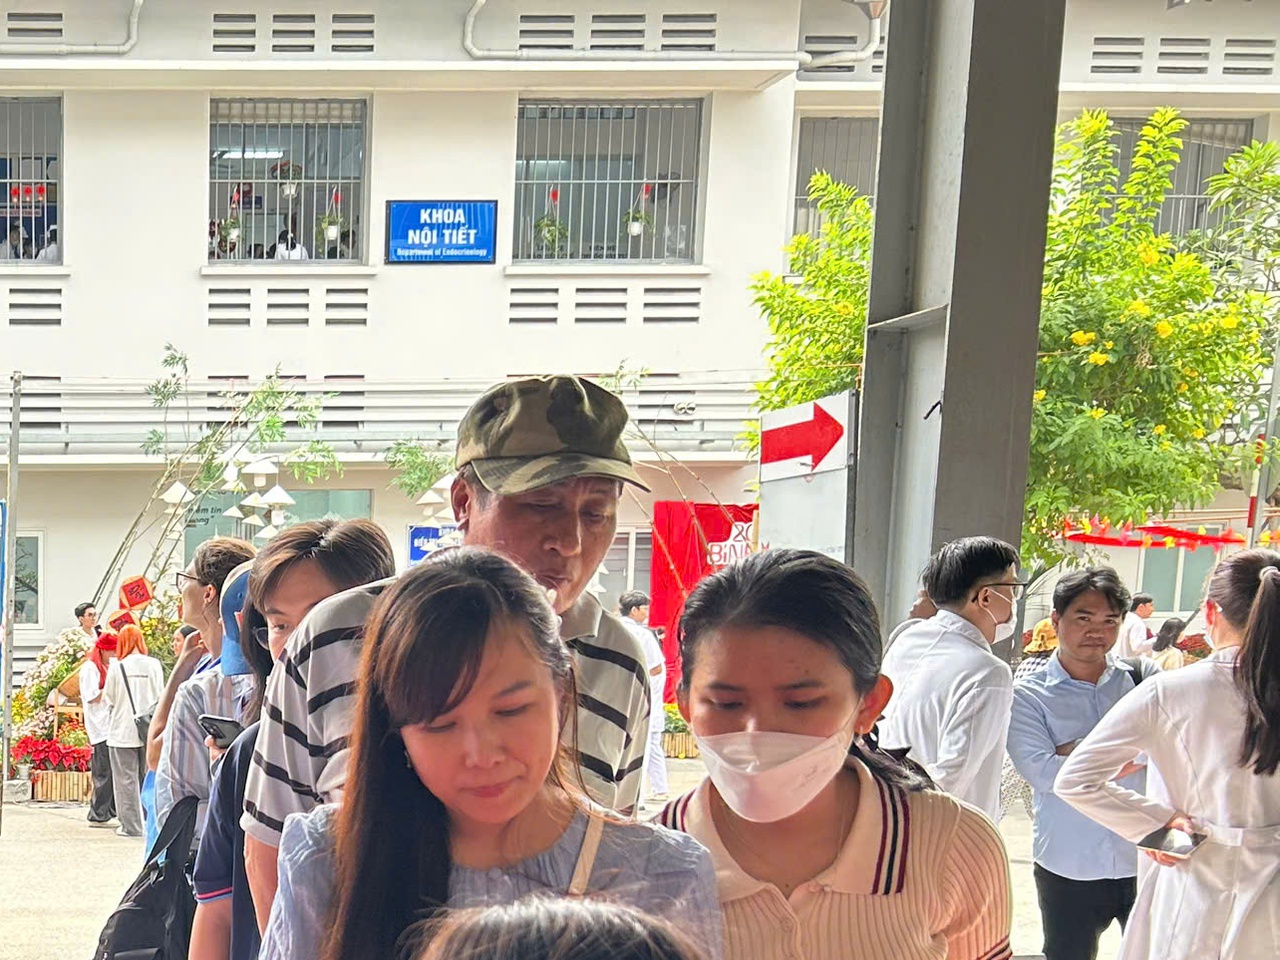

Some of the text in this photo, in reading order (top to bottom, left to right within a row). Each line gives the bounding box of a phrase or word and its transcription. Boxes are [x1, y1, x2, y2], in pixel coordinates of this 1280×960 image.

[420, 208, 465, 224] KHOA
[407, 225, 477, 248] NỘI TIẾT
